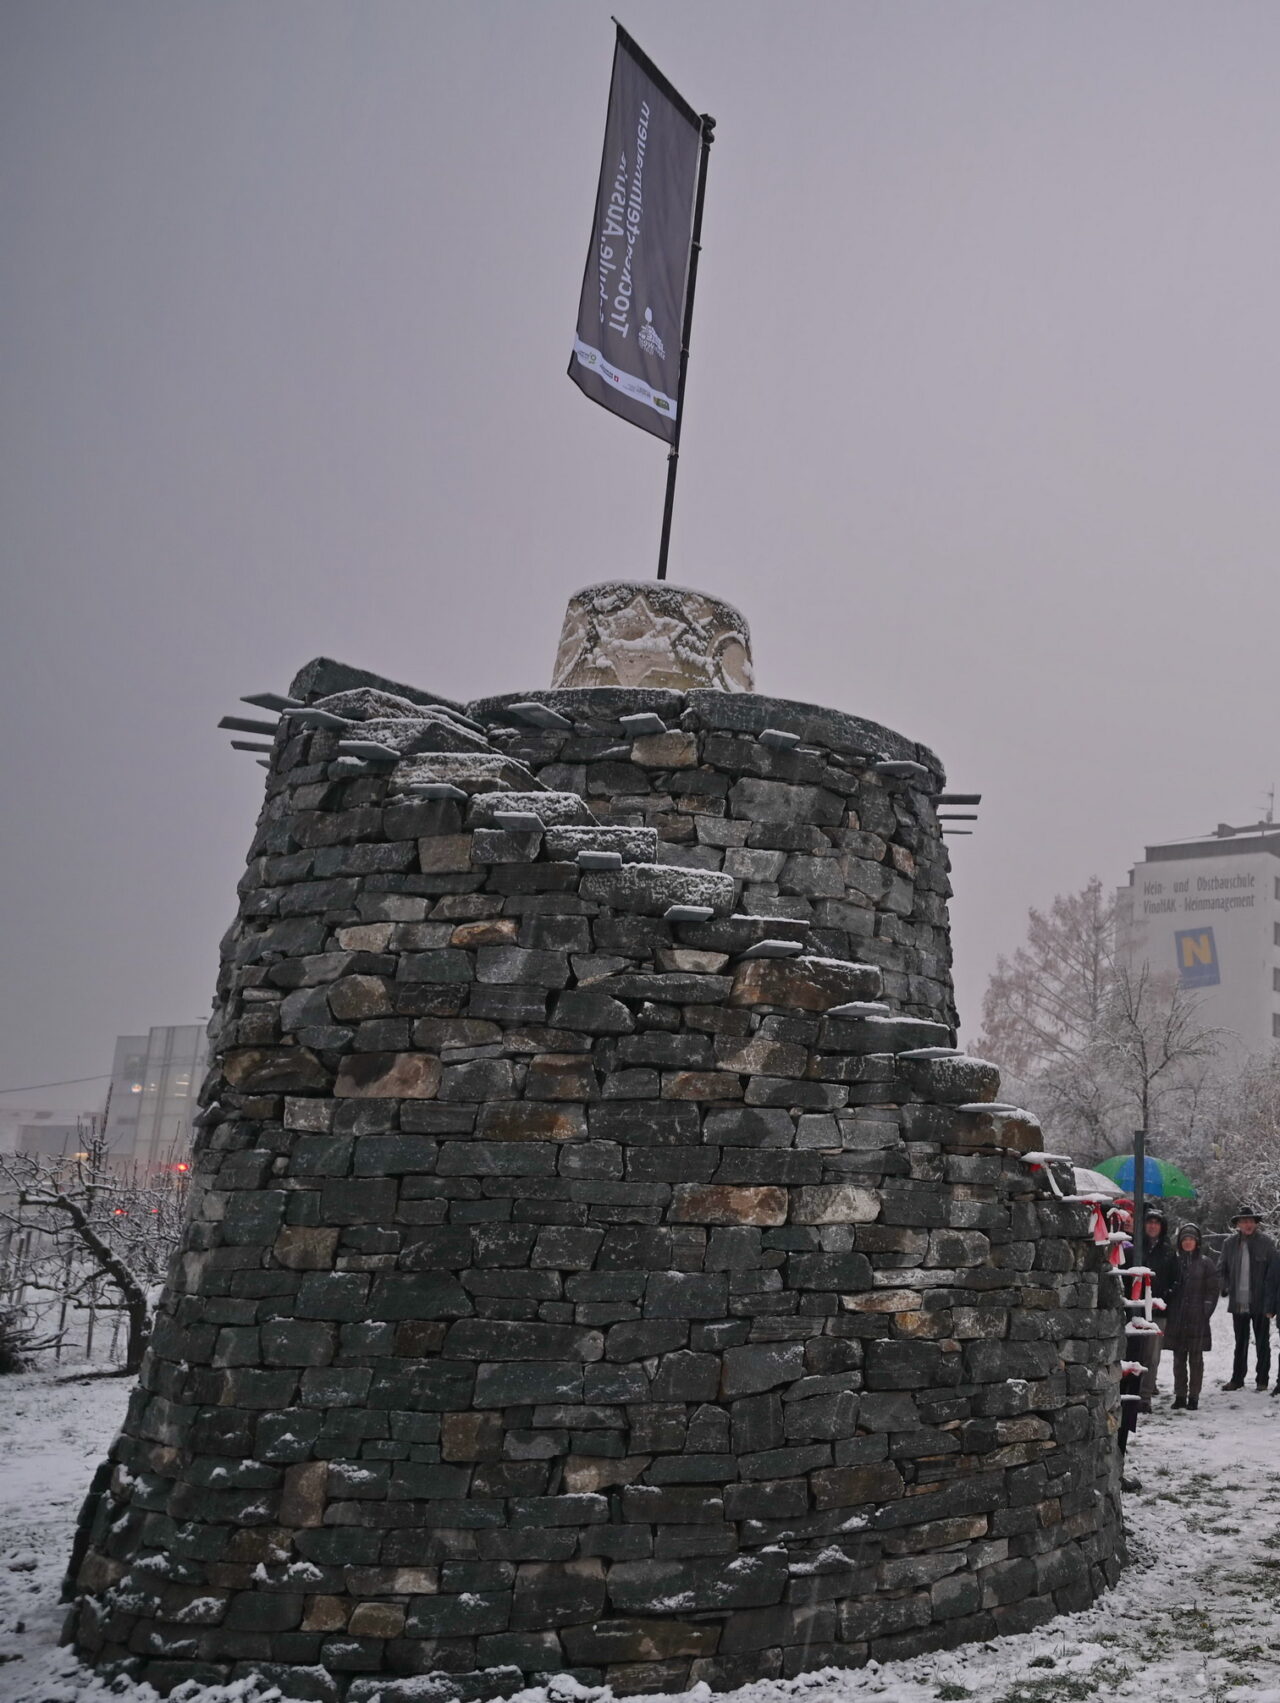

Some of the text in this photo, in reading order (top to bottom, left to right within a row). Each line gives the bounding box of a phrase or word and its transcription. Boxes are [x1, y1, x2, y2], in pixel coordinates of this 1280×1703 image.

[1173, 877, 1189, 893] und
[1196, 873, 1256, 892] Obstbauschule
[1184, 894, 1256, 913] Weinmanagement
[1181, 933, 1213, 968] N
